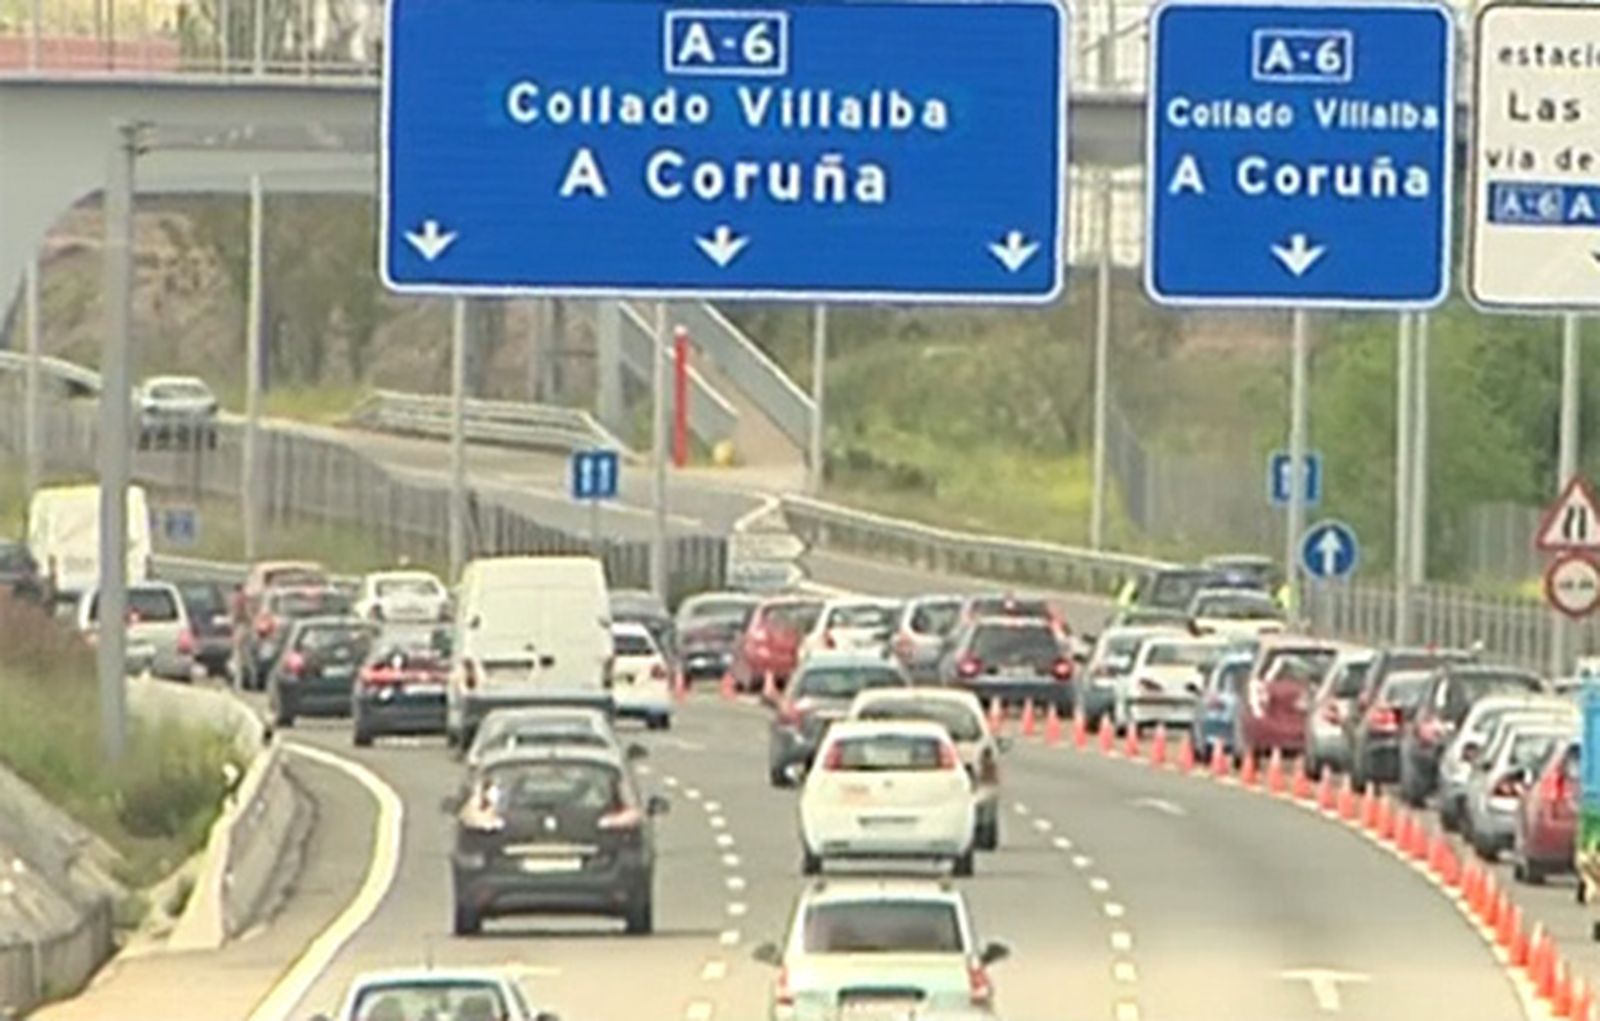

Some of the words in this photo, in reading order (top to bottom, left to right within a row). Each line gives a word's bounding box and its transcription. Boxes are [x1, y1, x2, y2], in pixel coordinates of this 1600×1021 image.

[678, 23, 775, 63] A-6
[1263, 39, 1342, 73] A-6
[1498, 42, 1600, 68] estaci
[507, 81, 710, 125] Collado
[738, 86, 948, 130] Villalba
[1166, 97, 1294, 129] Collado
[1313, 98, 1440, 130] Villalba
[1508, 90, 1581, 122] Las
[1555, 146, 1594, 171] de
[560, 148, 607, 197] A
[646, 151, 887, 203] Coruña
[1169, 155, 1205, 194] A
[1236, 156, 1430, 197] Coruña
[1569, 192, 1595, 219] A
